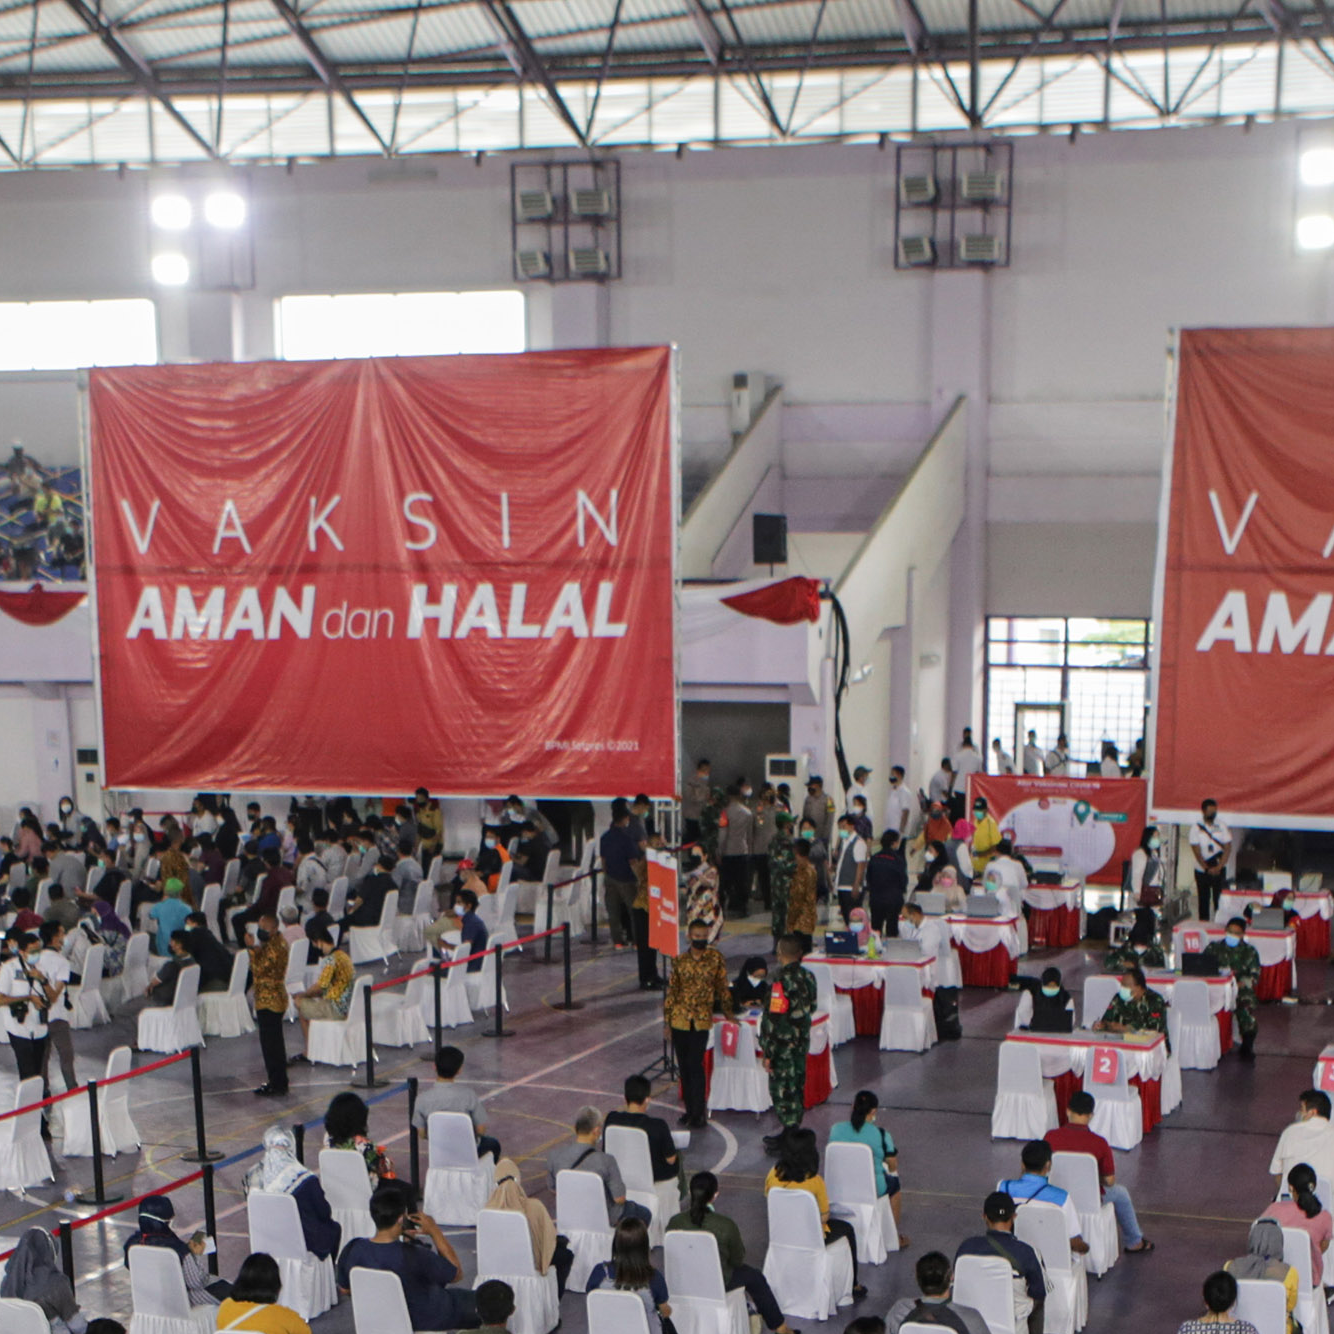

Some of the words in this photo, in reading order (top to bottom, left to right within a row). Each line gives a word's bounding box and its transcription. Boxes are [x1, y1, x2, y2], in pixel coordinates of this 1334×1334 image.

[120, 488, 619, 555] VAKSIN
[126, 584, 316, 641] AMAN
[321, 600, 395, 640] dan
[406, 581, 629, 640] HALAL
[1099, 1057, 1111, 1073] 2
